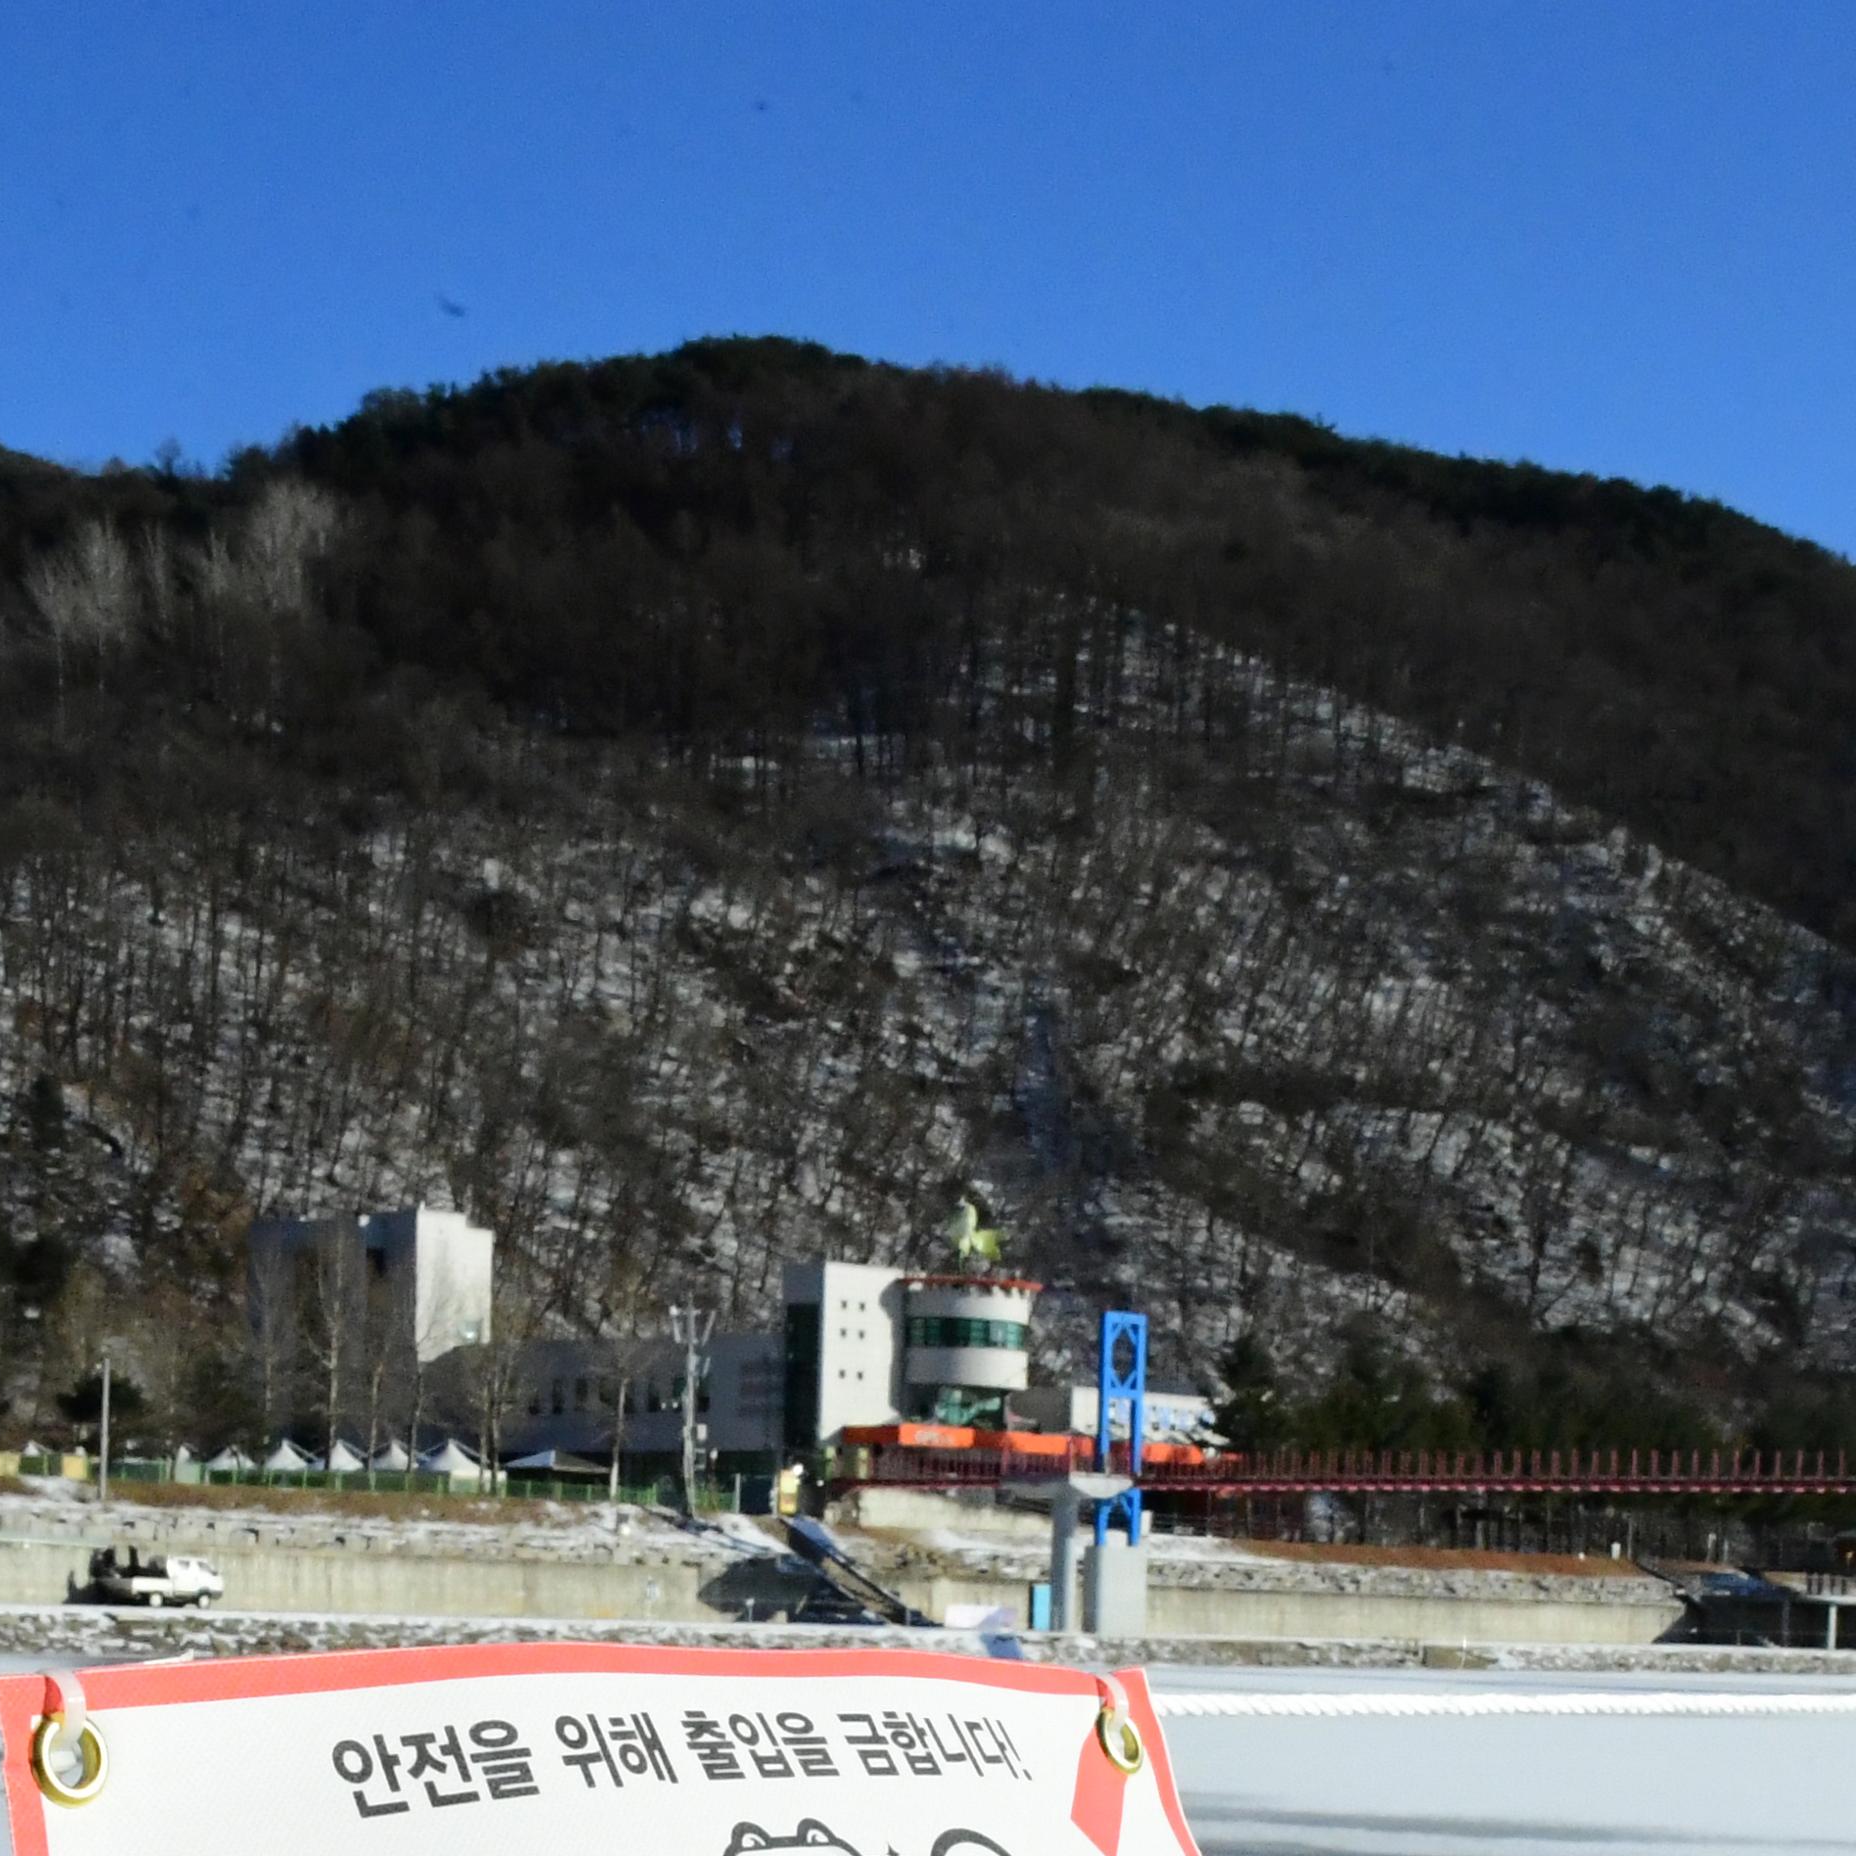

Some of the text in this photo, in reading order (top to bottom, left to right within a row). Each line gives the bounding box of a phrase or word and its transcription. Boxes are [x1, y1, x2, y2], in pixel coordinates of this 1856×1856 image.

[331, 1710, 1033, 1819] 안전을 위해 출입을 금합니다!
